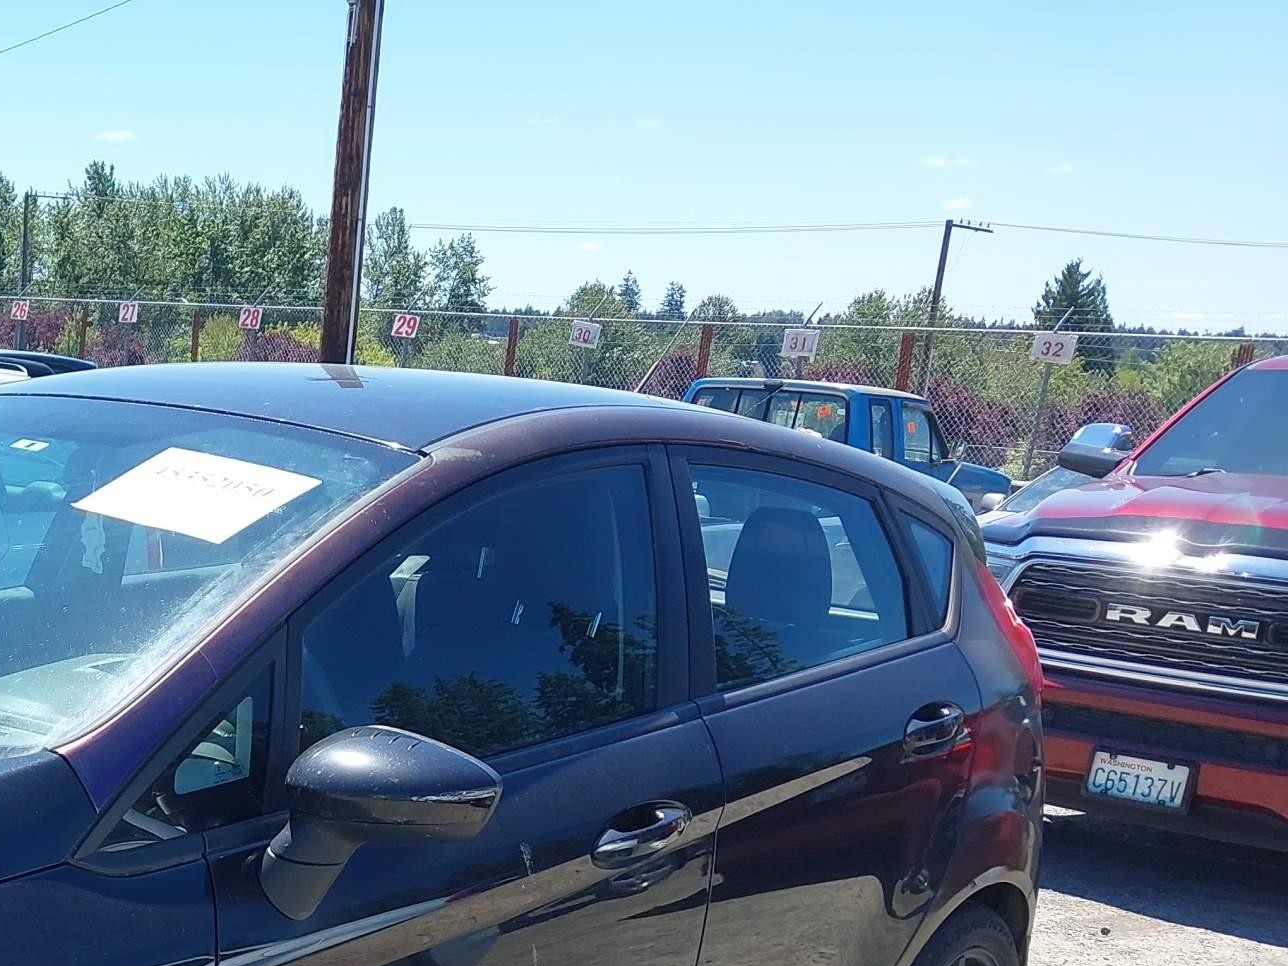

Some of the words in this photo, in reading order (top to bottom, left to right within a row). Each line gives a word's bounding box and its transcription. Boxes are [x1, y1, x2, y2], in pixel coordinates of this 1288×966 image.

[12, 303, 26, 318] 26
[122, 304, 137, 322] 27
[240, 308, 259, 328] 28
[394, 316, 417, 336] 29
[575, 327, 591, 342] 30
[789, 335, 806, 350] 31
[1040, 340, 1064, 358] 32
[1106, 602, 1260, 640] RAM
[1099, 758, 1153, 773] WASHINGTON
[1092, 767, 1181, 803] C65137V
